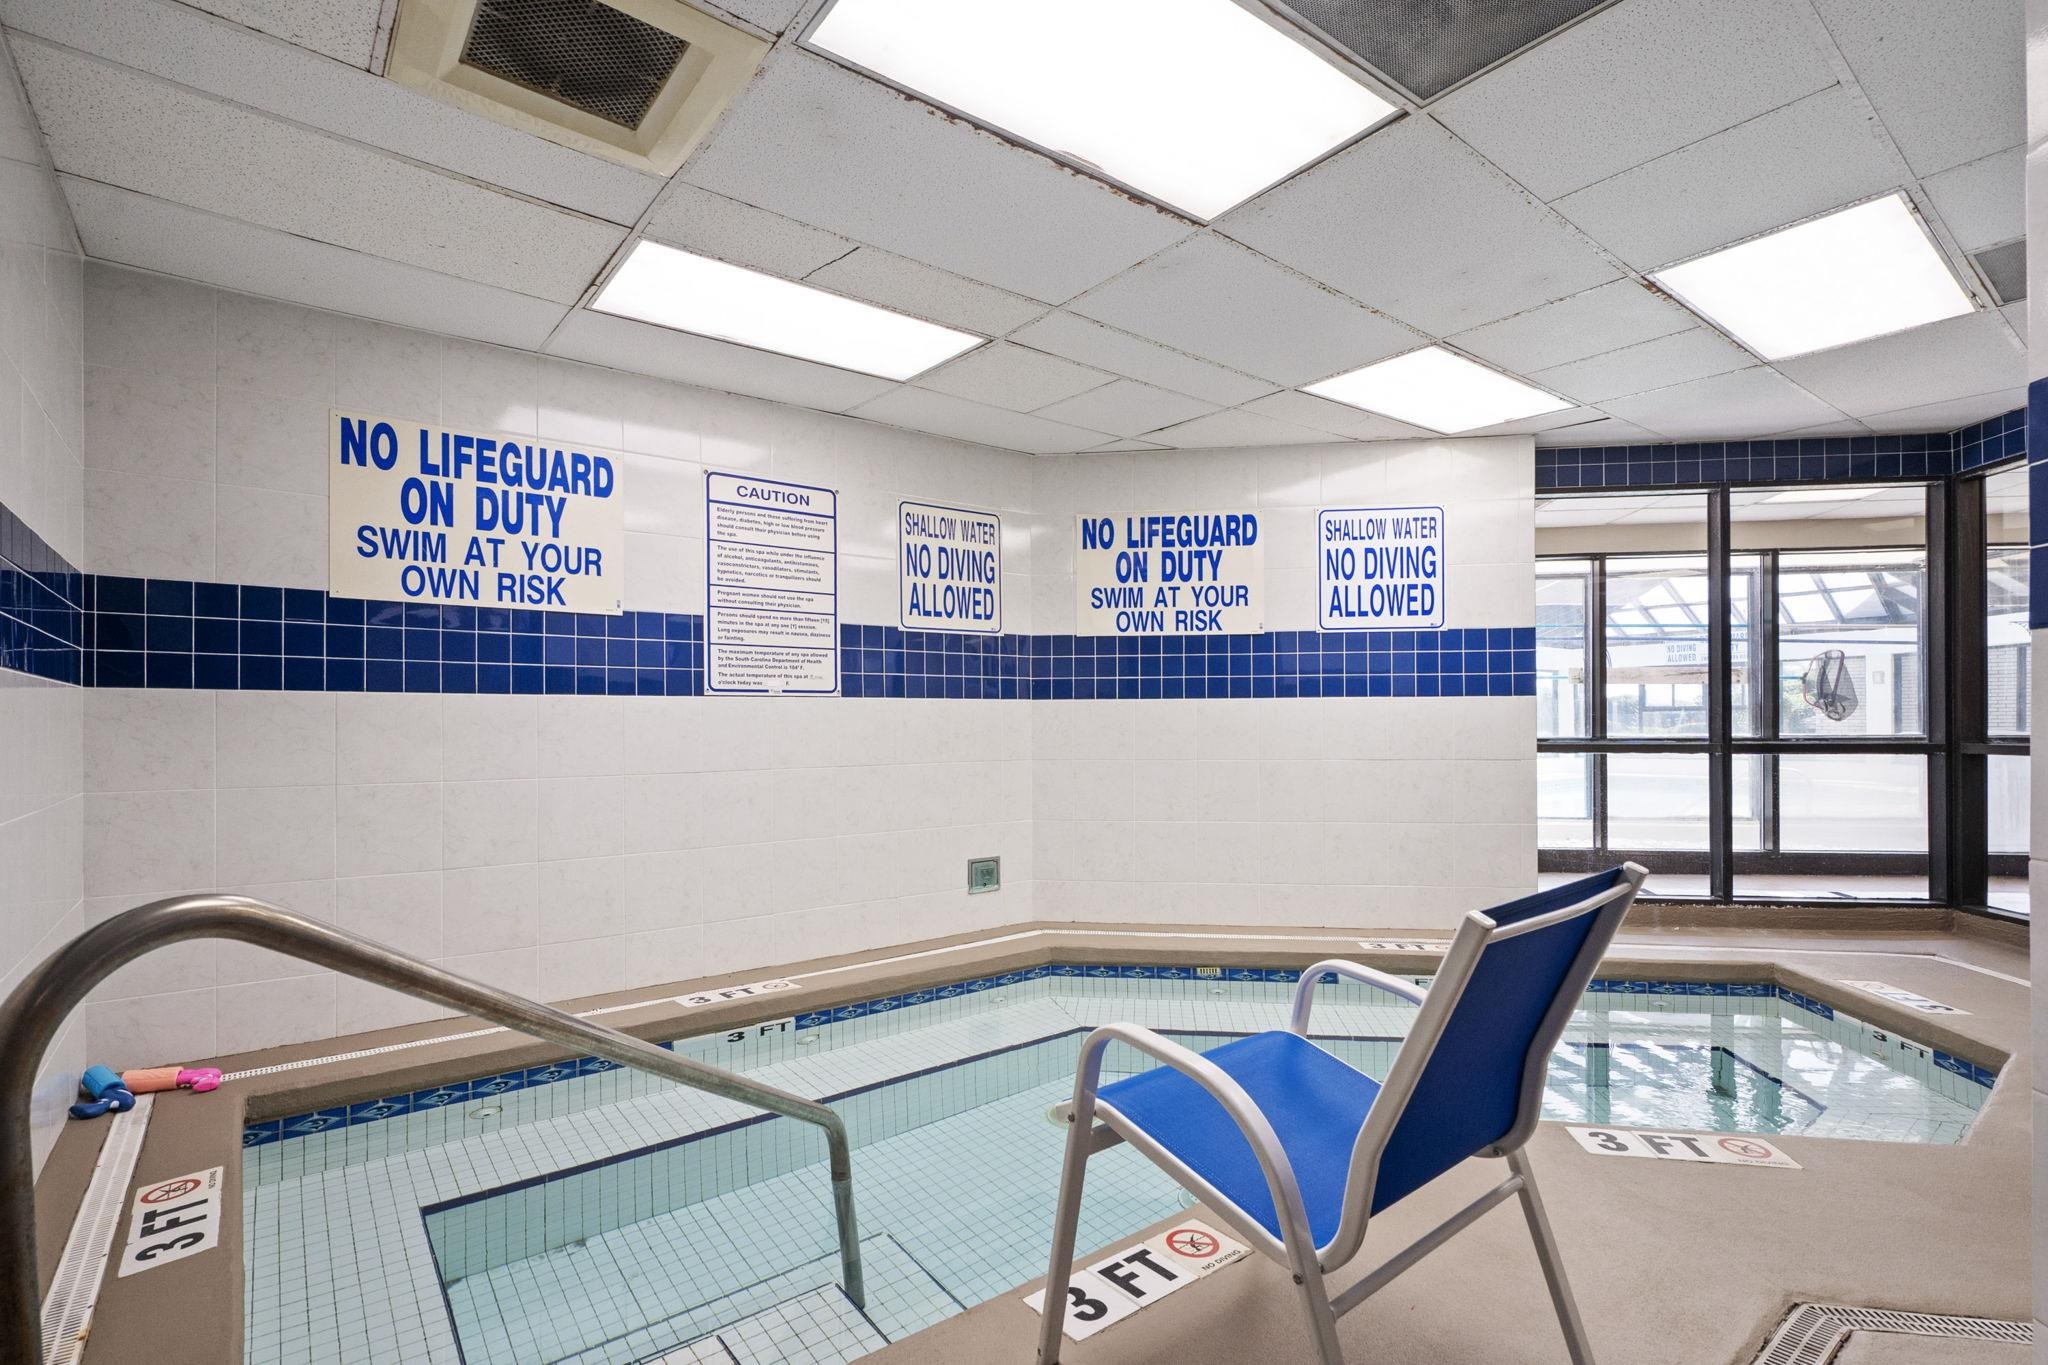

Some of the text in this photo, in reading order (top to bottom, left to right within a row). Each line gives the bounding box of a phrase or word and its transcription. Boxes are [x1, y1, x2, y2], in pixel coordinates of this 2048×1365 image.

[341, 418, 614, 498] NO LIFEGUARD
[400, 477, 566, 538] ON DUTY
[736, 486, 810, 506] CAUTION
[905, 512, 996, 545] SHALLOW WATER
[1083, 514, 1258, 549] NO LIFEGUARD
[1325, 517, 1437, 541] SHALLOW WATER
[357, 525, 602, 576] SWIM AT YOUR
[906, 545, 994, 583] NO DIVING
[1116, 549, 1222, 583] ON DUTY
[1326, 545, 1436, 581] NO DIVING
[401, 565, 565, 605] OWN RISK
[909, 583, 995, 621] ALLOWED
[1092, 585, 1248, 608] SWIM AT YOUR
[1329, 583, 1435, 617] ALLOWED
[1117, 610, 1221, 632] OWN RISK
[689, 987, 755, 1004] 3 FT
[727, 1021, 792, 1043] 3 FT
[1873, 1030, 1930, 1058] 3 FT
[1588, 1132, 1710, 1158] 3 FT
[135, 1198, 208, 1262] 3 FT
[1201, 1249, 1241, 1272] NO DIVING
[1067, 1248, 1179, 1322] 3 FT
